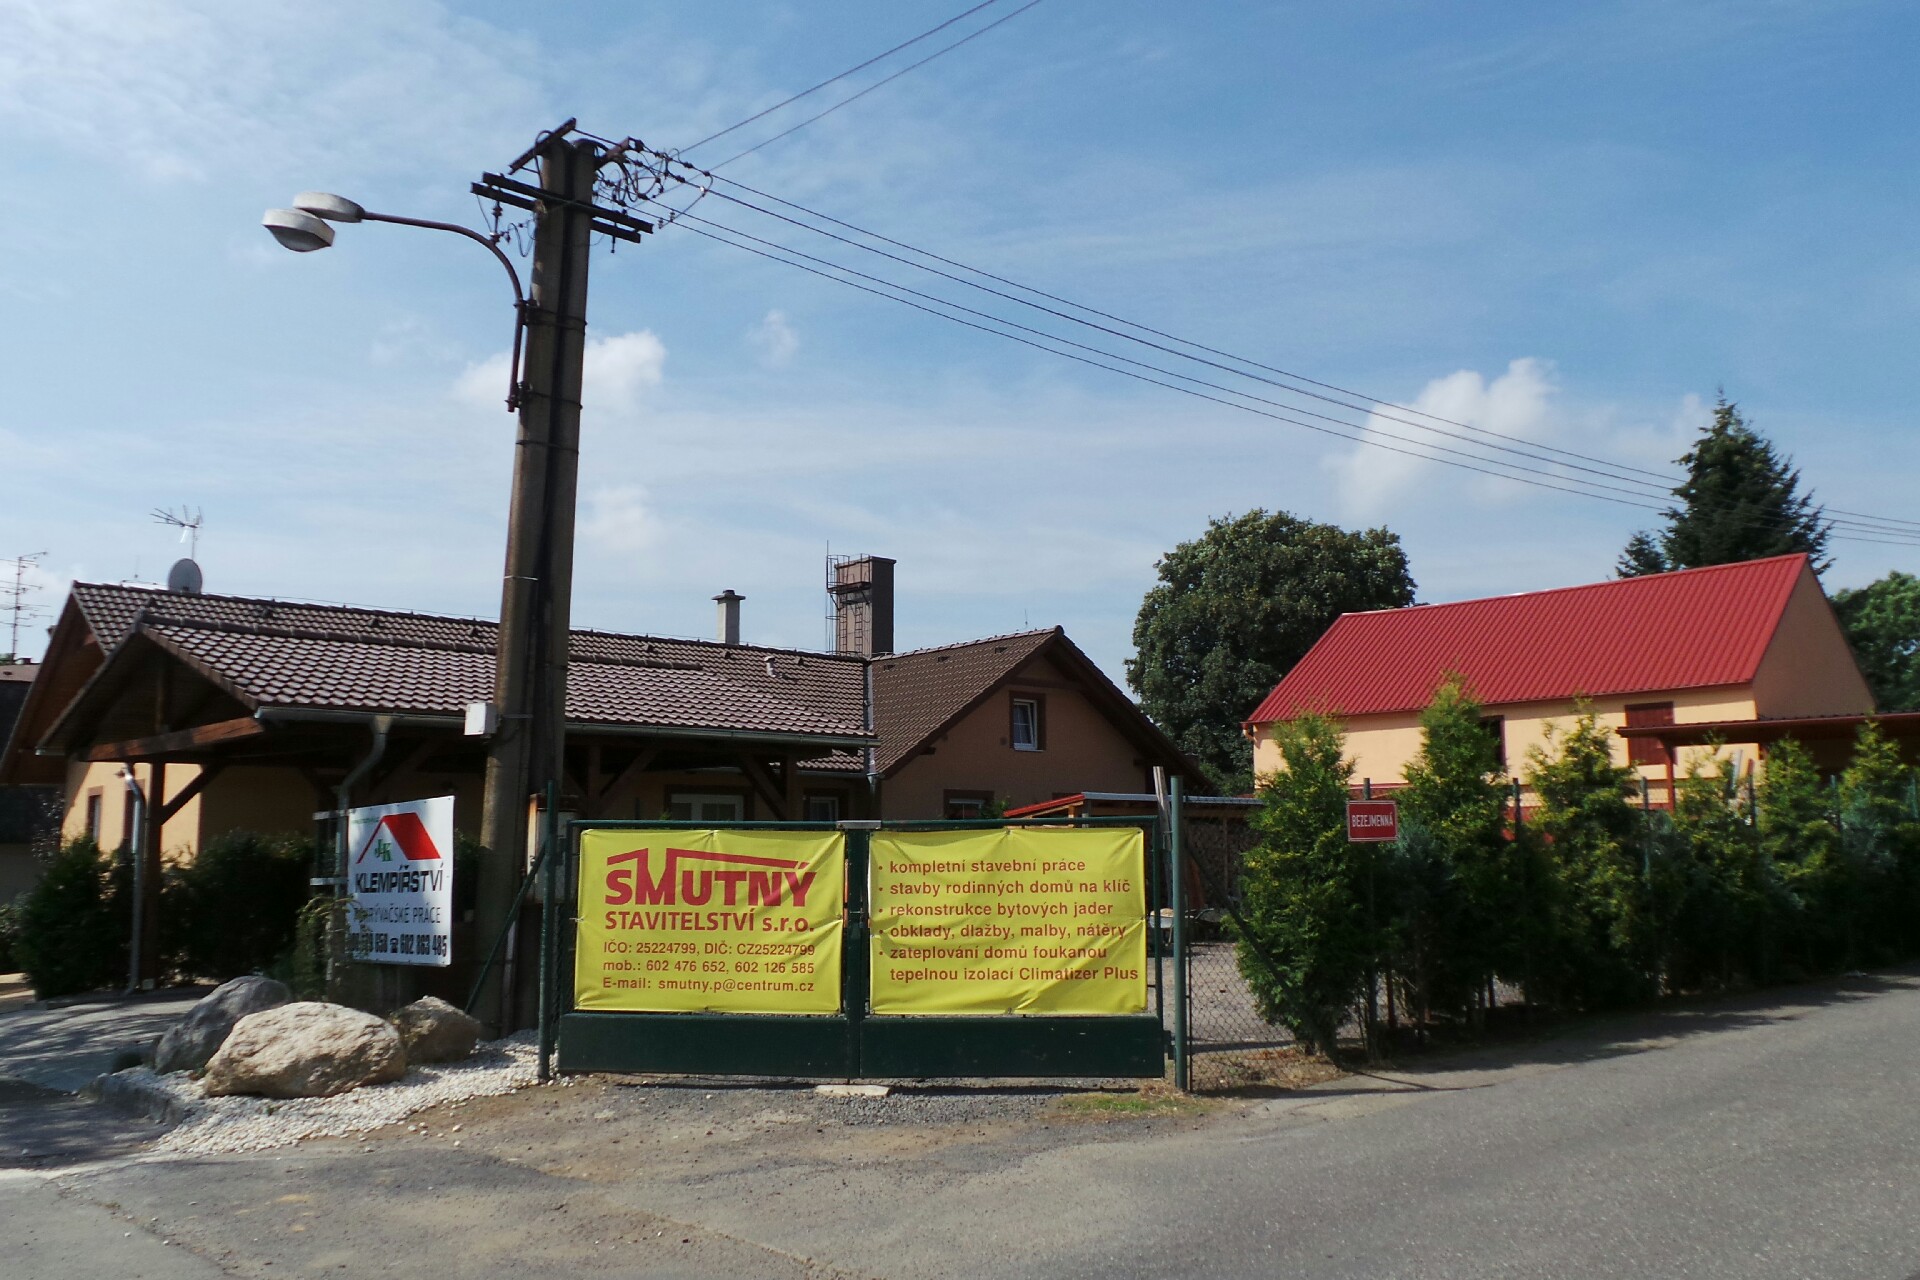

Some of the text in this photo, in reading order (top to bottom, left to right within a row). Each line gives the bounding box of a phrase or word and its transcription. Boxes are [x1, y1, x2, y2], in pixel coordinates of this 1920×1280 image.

[1351, 811, 1394, 828] BEZEJMENNÁ
[889, 859, 1086, 876] kompletní stavební práce
[354, 862, 444, 894] KLEMPÍŘSTVÍ
[604, 847, 818, 907] SMUTNÝ
[889, 879, 1131, 897] stavby rodinných domů na klíč
[412, 901, 441, 924] PRÁCE
[890, 901, 1114, 918] rekonstrukce bytových jader
[604, 908, 815, 933] STAVITELSTVÍ s.r.o.
[890, 923, 1127, 941] obklady, dlažby, malby, nátěry
[432, 934, 448, 958] 485
[603, 939, 815, 957] IČO: 25224799, DIČ: CZ25224799
[889, 945, 1108, 962] zateplování domů foukanou
[603, 959, 814, 974] mob.: 602 476 652, 602 126 585
[890, 966, 1139, 984] tepelnou izolací Climatizer Plus
[603, 977, 815, 993] E-mail: smutny.p@centrum.cz
